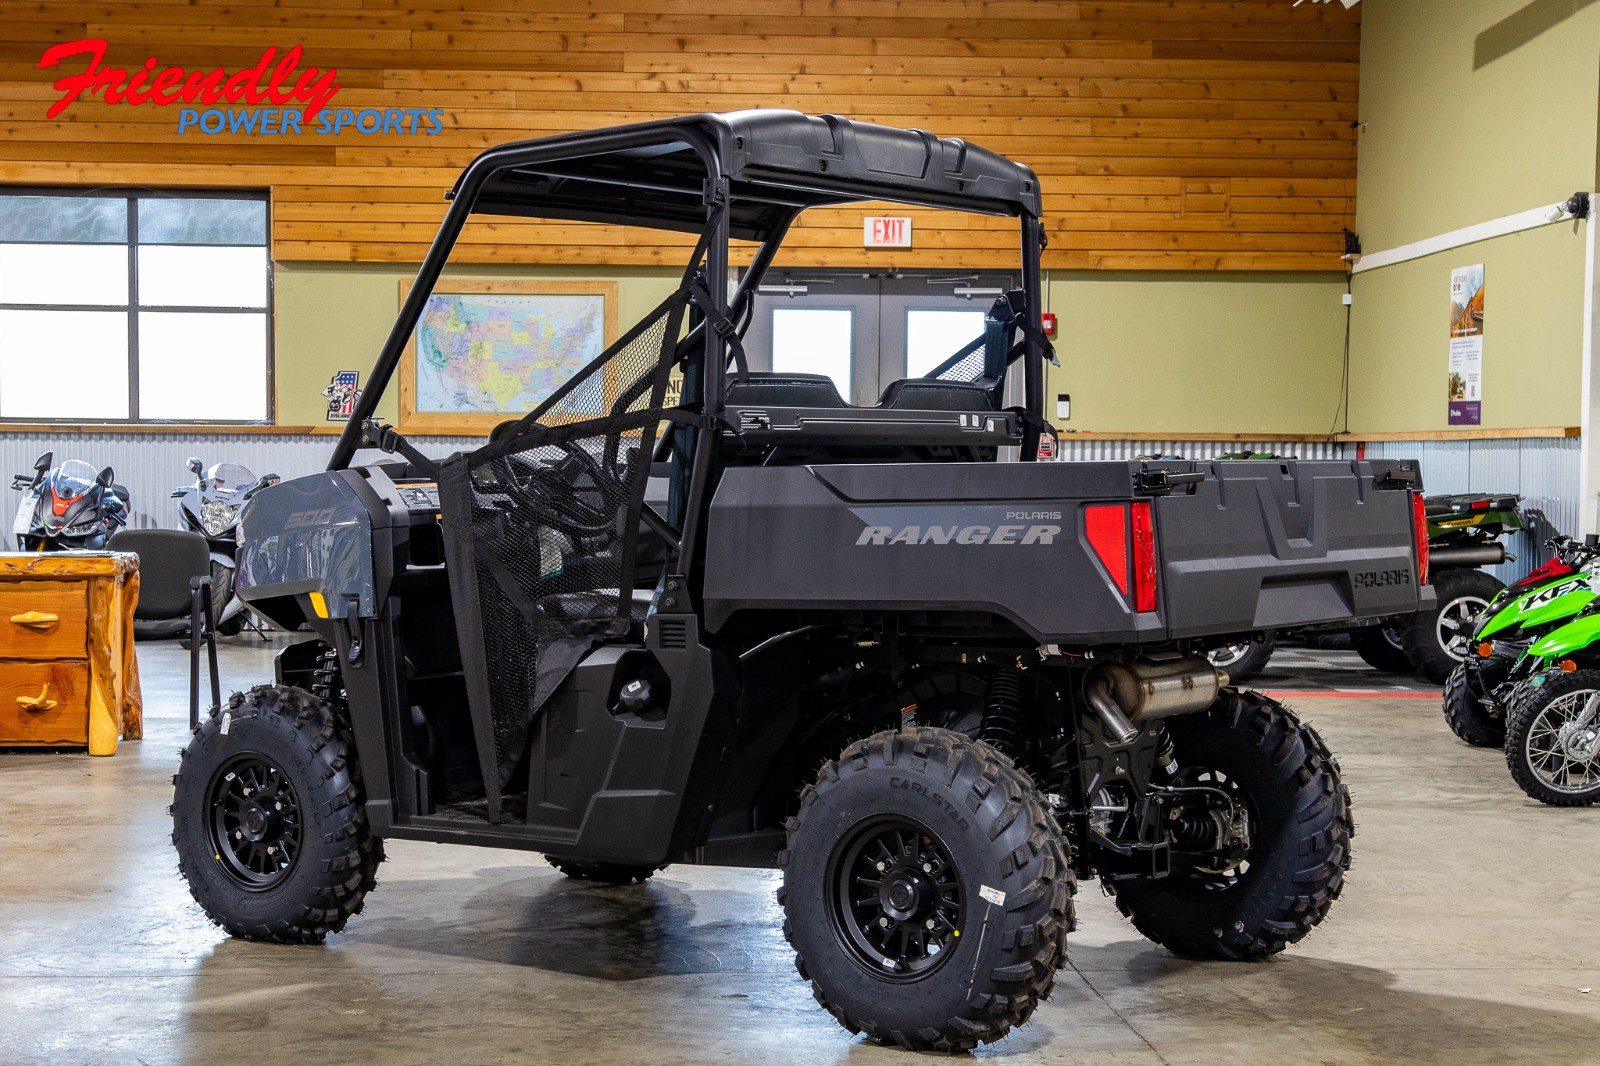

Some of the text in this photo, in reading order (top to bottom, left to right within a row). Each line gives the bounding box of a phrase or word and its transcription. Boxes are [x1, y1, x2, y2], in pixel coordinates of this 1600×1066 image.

[873, 219, 904, 244] EXIT
[1006, 511, 1062, 520] POLARIS
[855, 525, 1061, 546] RANGER
[1354, 569, 1409, 589] POLARIS
[1522, 575, 1592, 612] KFX
[890, 777, 969, 834] CARLSTAR
